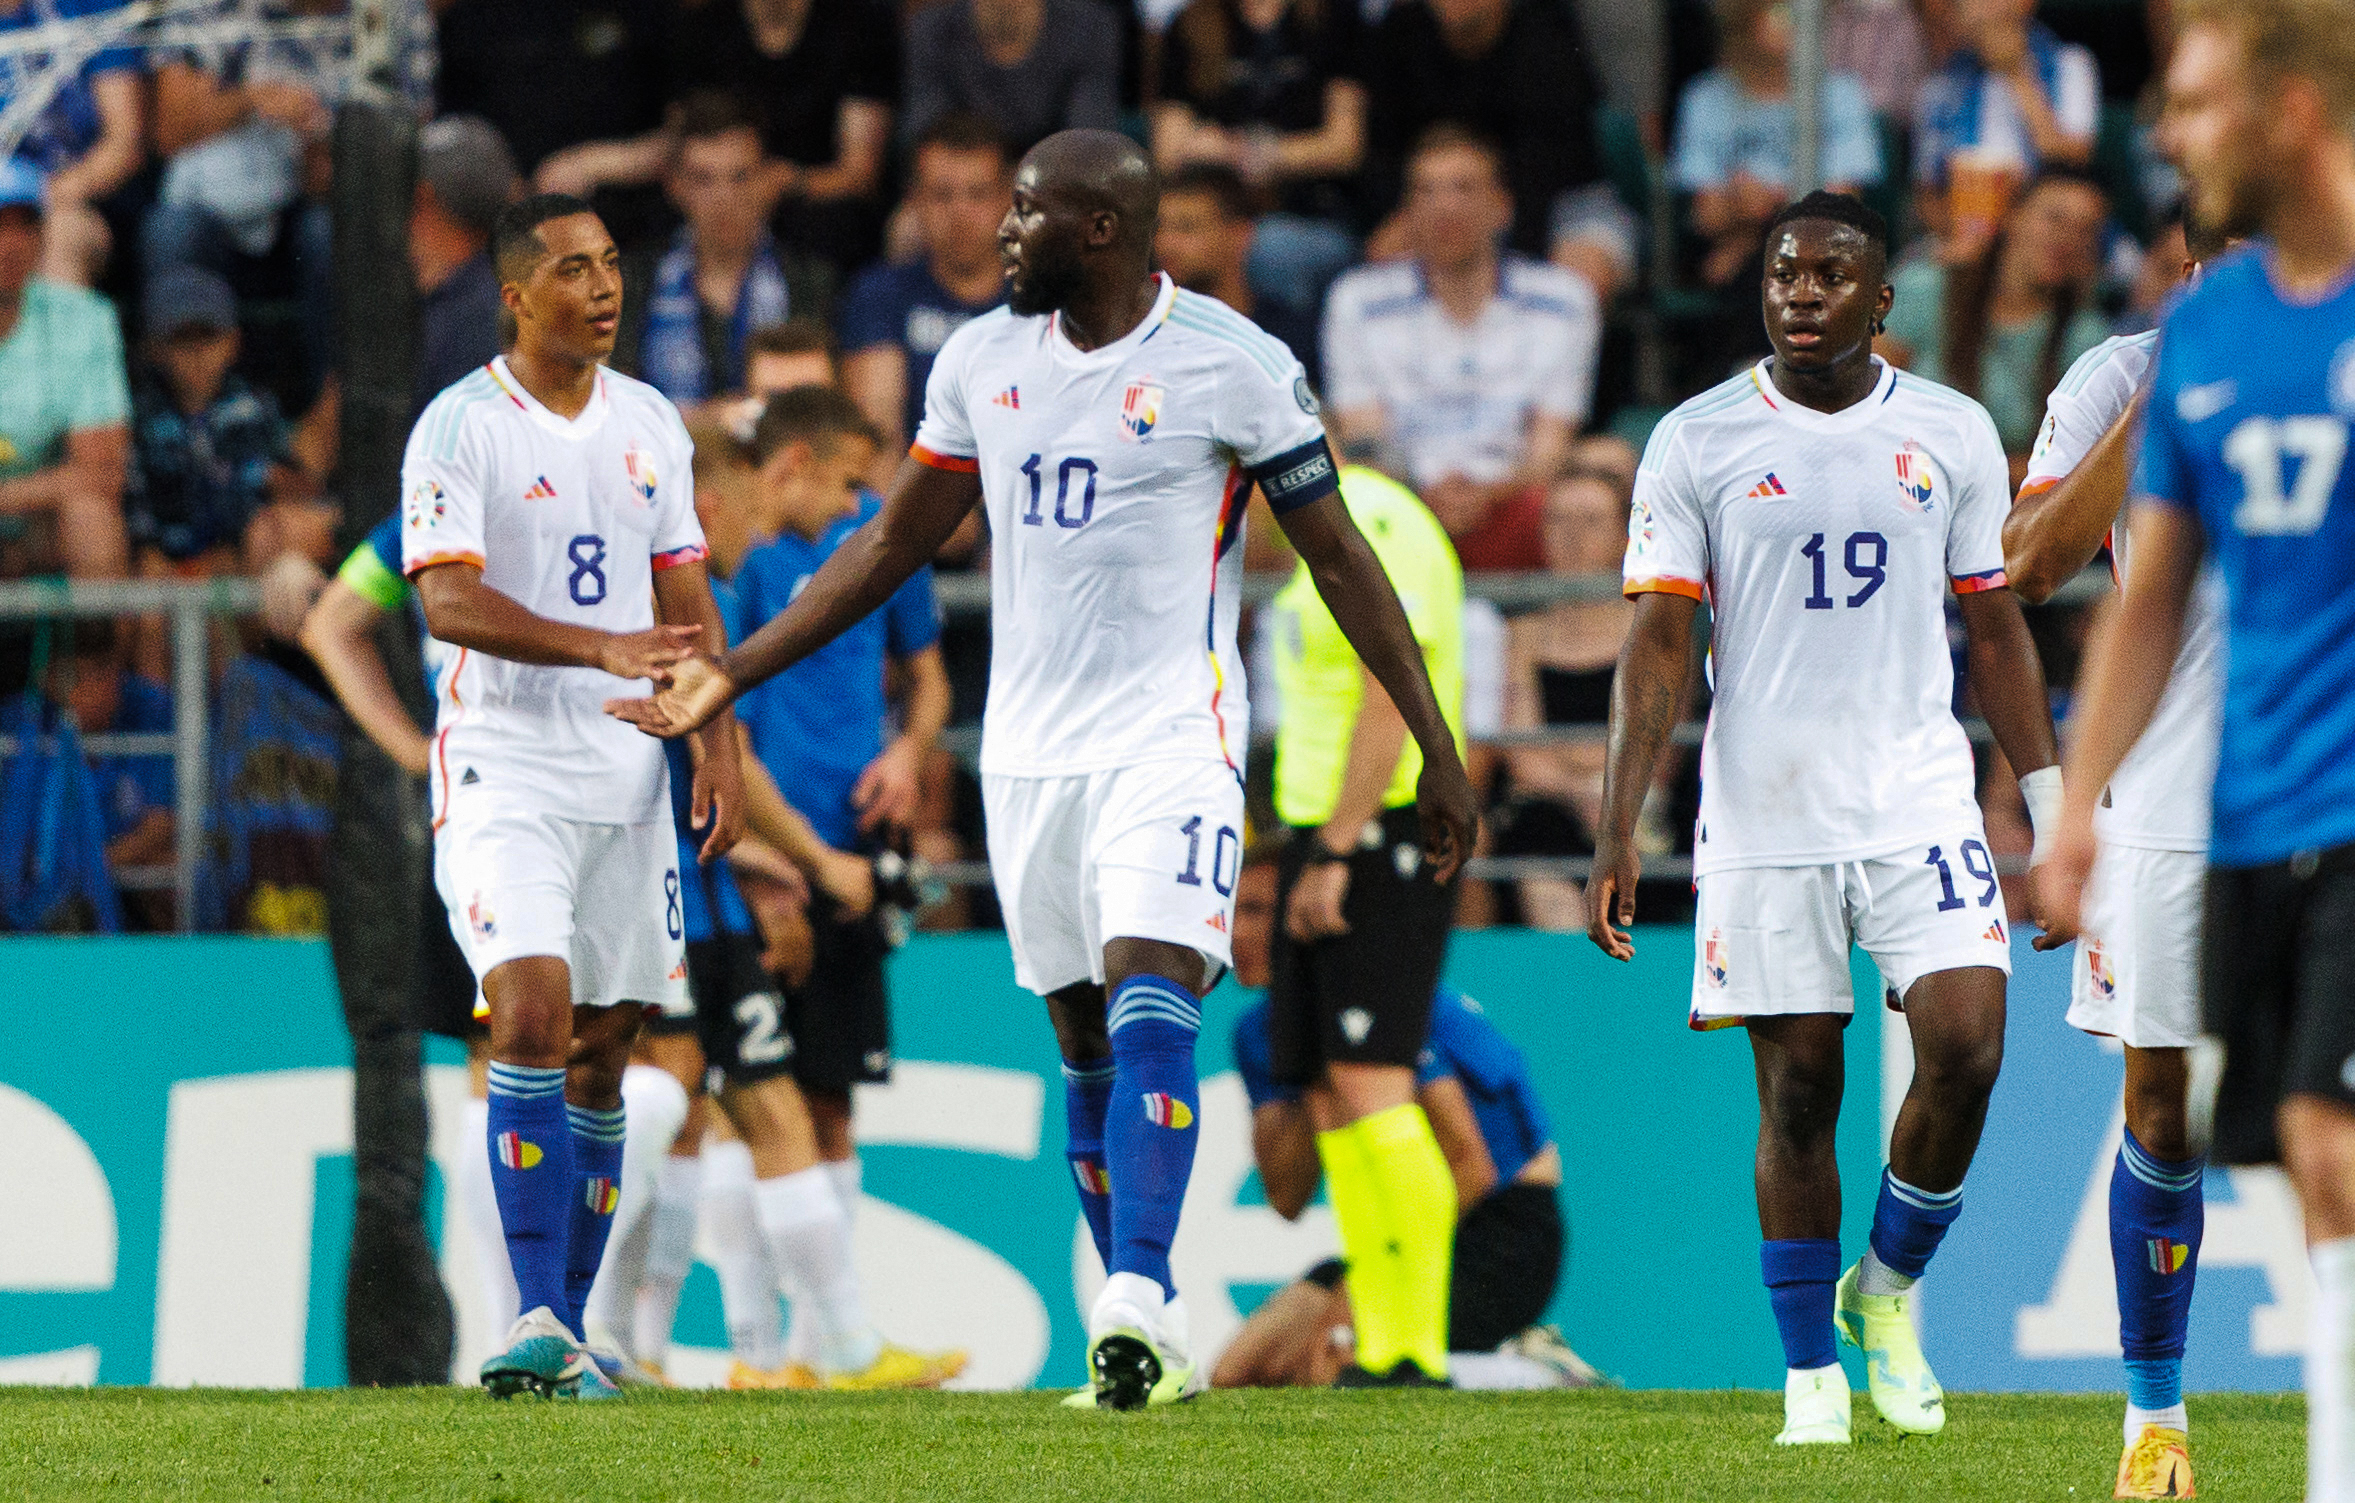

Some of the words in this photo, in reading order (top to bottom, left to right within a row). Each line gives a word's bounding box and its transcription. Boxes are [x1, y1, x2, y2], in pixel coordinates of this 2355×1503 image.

[1020, 453, 1099, 529] 10
[2222, 416, 2346, 535] 17
[568, 534, 606, 605] 8
[1801, 531, 1887, 609] 19
[1177, 815, 1239, 898] 10
[1924, 839, 1997, 912] 19
[664, 867, 682, 940] 8
